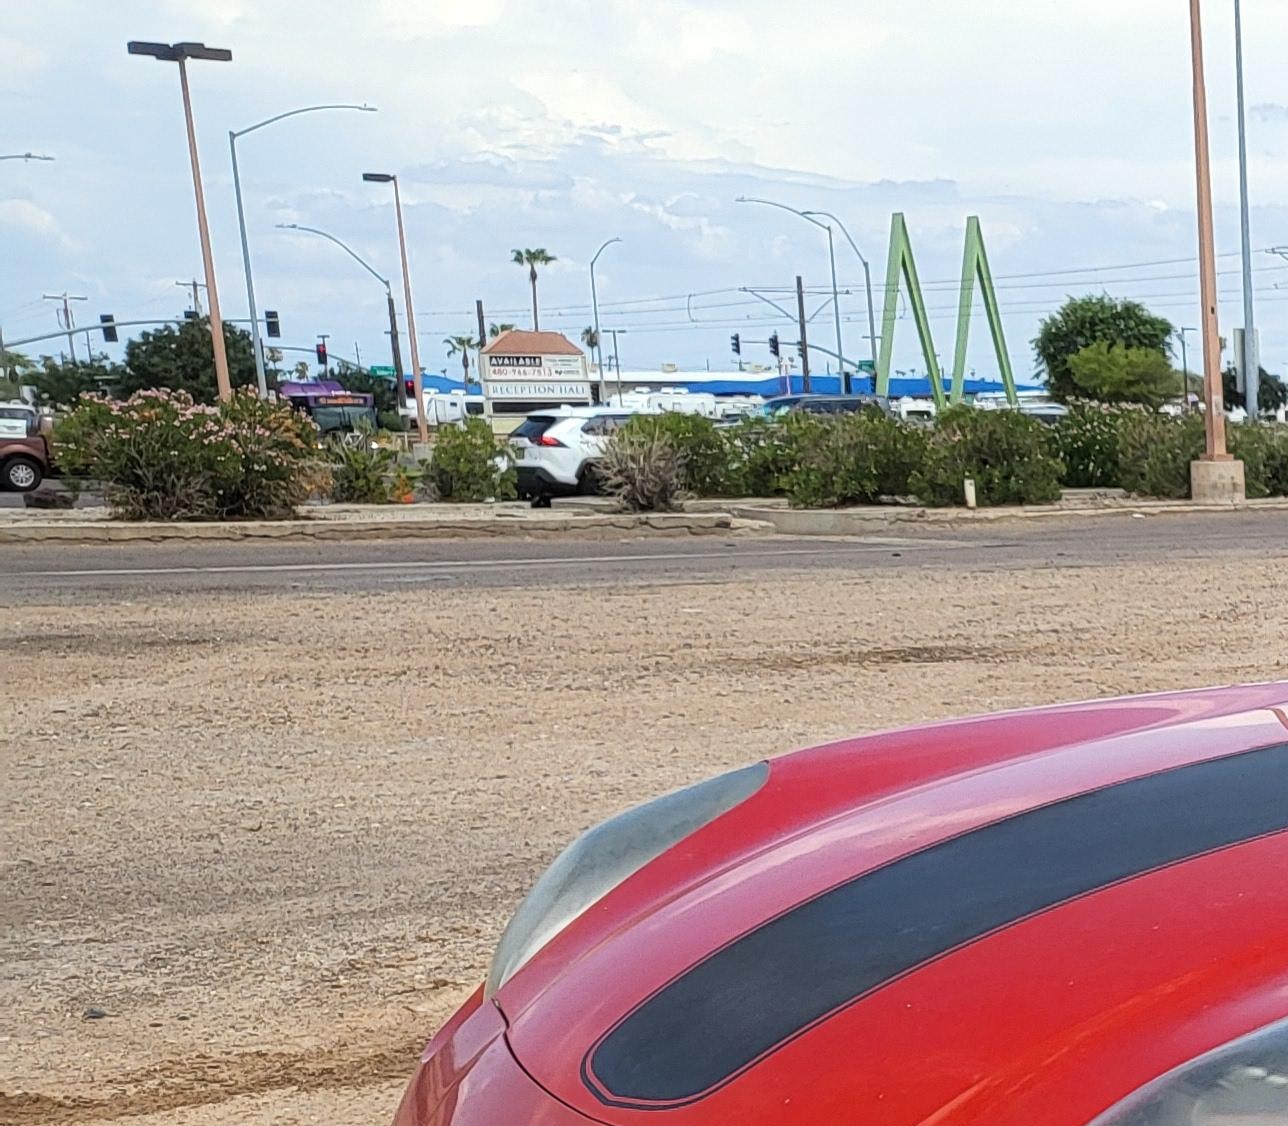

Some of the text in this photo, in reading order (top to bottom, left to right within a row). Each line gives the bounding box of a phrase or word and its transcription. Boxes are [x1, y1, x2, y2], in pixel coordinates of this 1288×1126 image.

[490, 356, 541, 366] AVAILABLE
[492, 385, 586, 395] RECEPTION HALL
